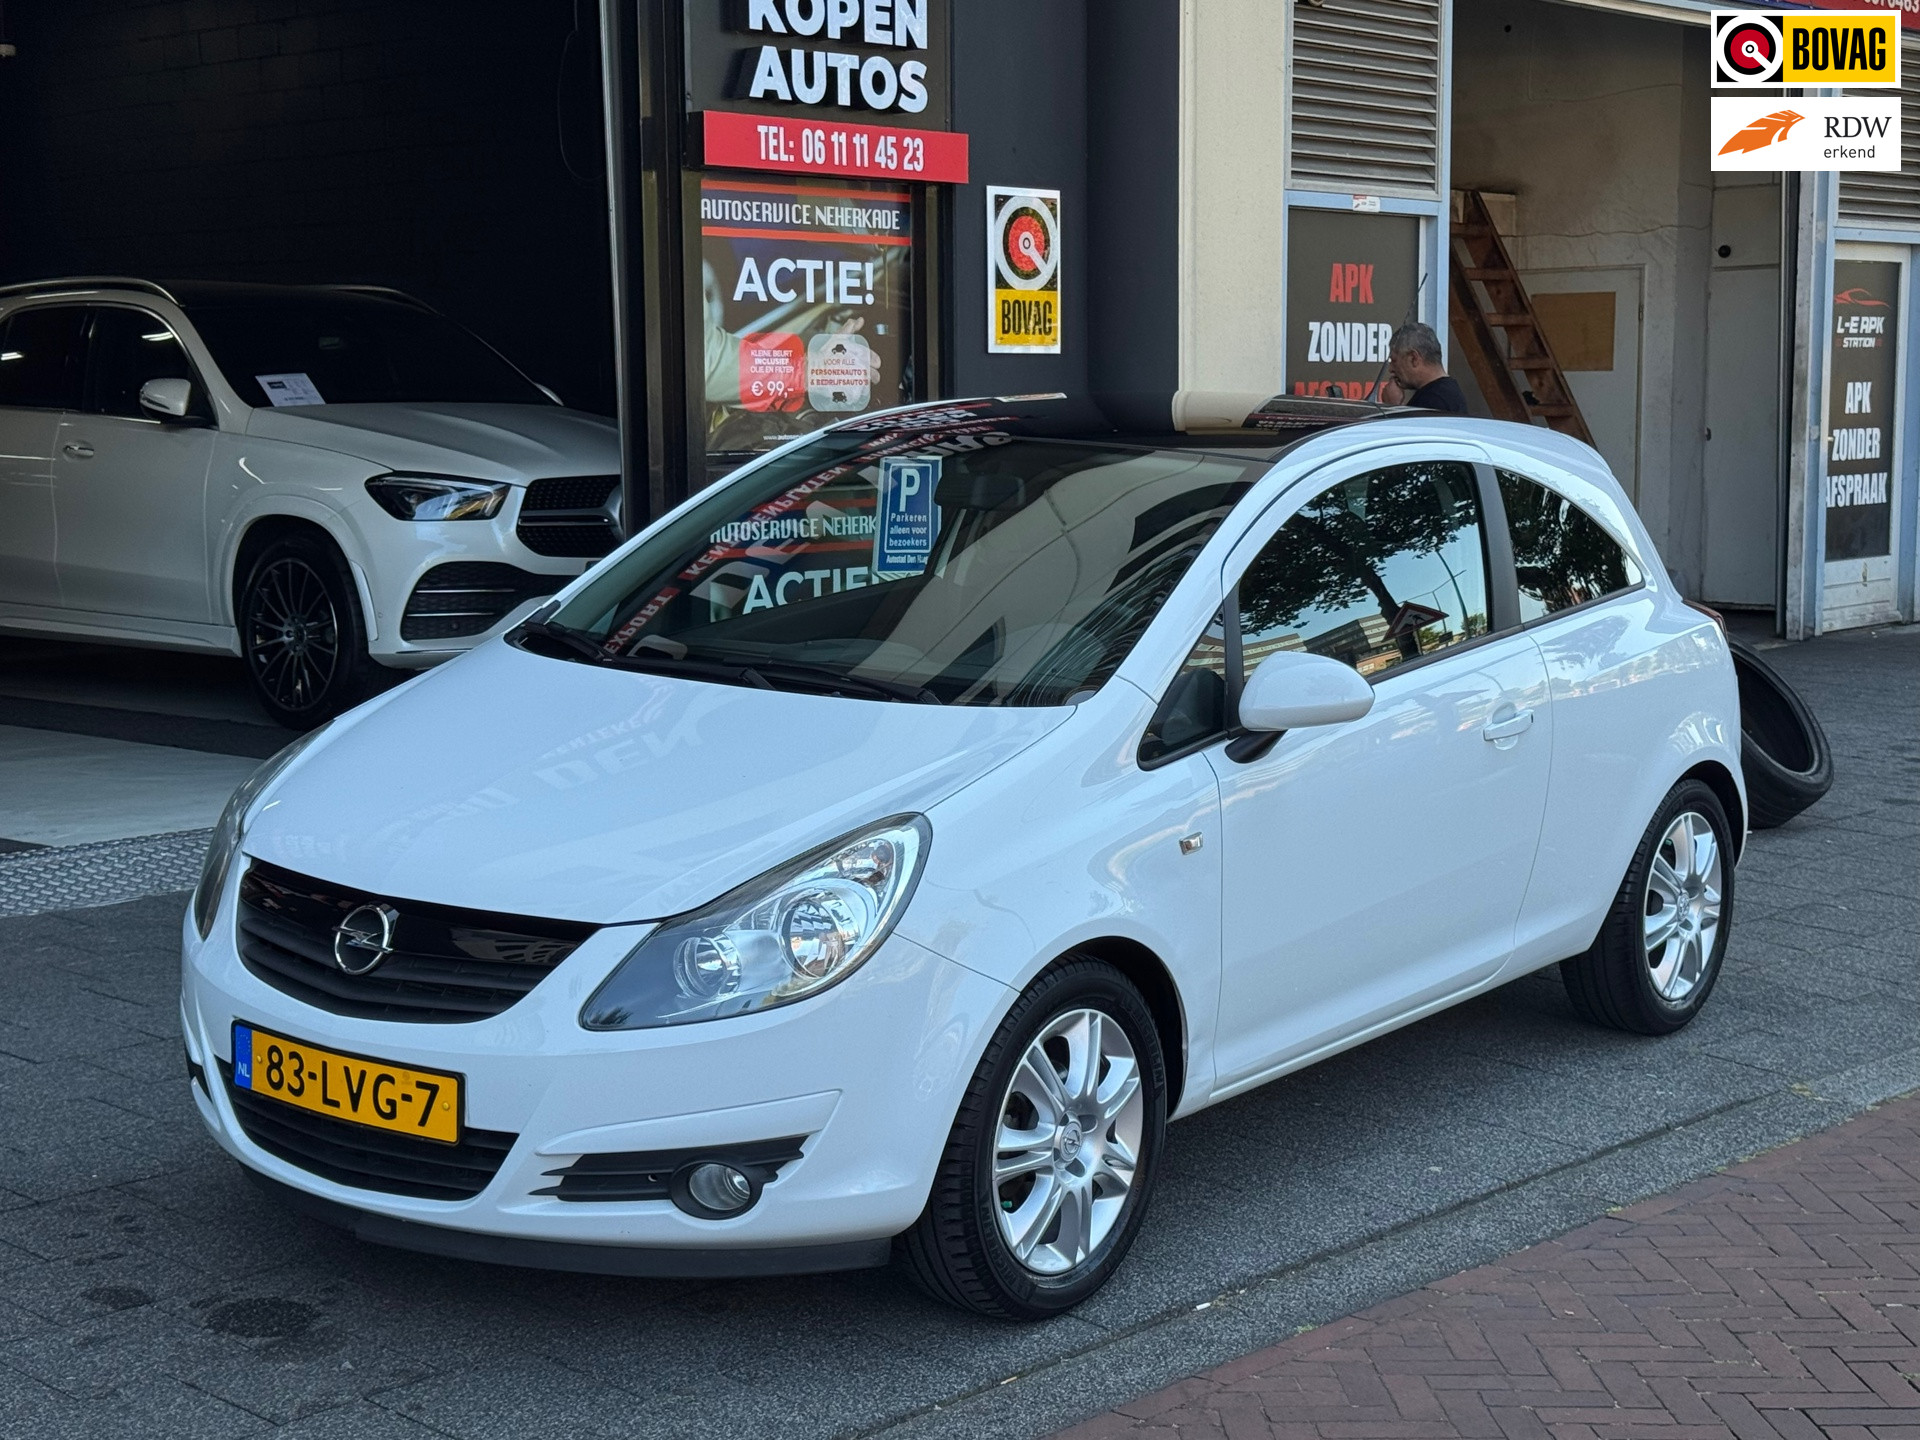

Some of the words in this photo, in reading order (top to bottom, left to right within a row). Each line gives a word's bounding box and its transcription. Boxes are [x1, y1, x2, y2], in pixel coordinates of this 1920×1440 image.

[749, 0, 928, 50] KOPEN
[749, 45, 928, 113] AUTOS
[757, 125, 794, 162] TEL:
[802, 128, 826, 164] 06
[831, 132, 847, 166] 11
[853, 133, 868, 167] 11
[874, 136, 898, 170] 45
[903, 137, 924, 171] 23
[701, 198, 811, 224] AUTOSERVICE
[816, 206, 900, 230] NEHERKADE
[733, 257, 874, 306] ACTIE!
[1330, 263, 1374, 304] APK
[1002, 299, 1052, 336] BOVAG
[1860, 316, 1884, 334] APK
[1308, 322, 1392, 362] ZONDER
[1843, 337, 1875, 348] STATION
[767, 381, 794, 398] 99,-
[1845, 382, 1872, 414] APK
[1832, 428, 1880, 461] ZONDER
[900, 468, 920, 512] P
[890, 525, 910, 534] alleen
[912, 526, 927, 534] voor
[891, 513, 926, 522] Parkeren
[890, 538, 926, 546] bezoekers
[238, 1062, 250, 1078] NL
[266, 1044, 440, 1128] 83-LVG-7
